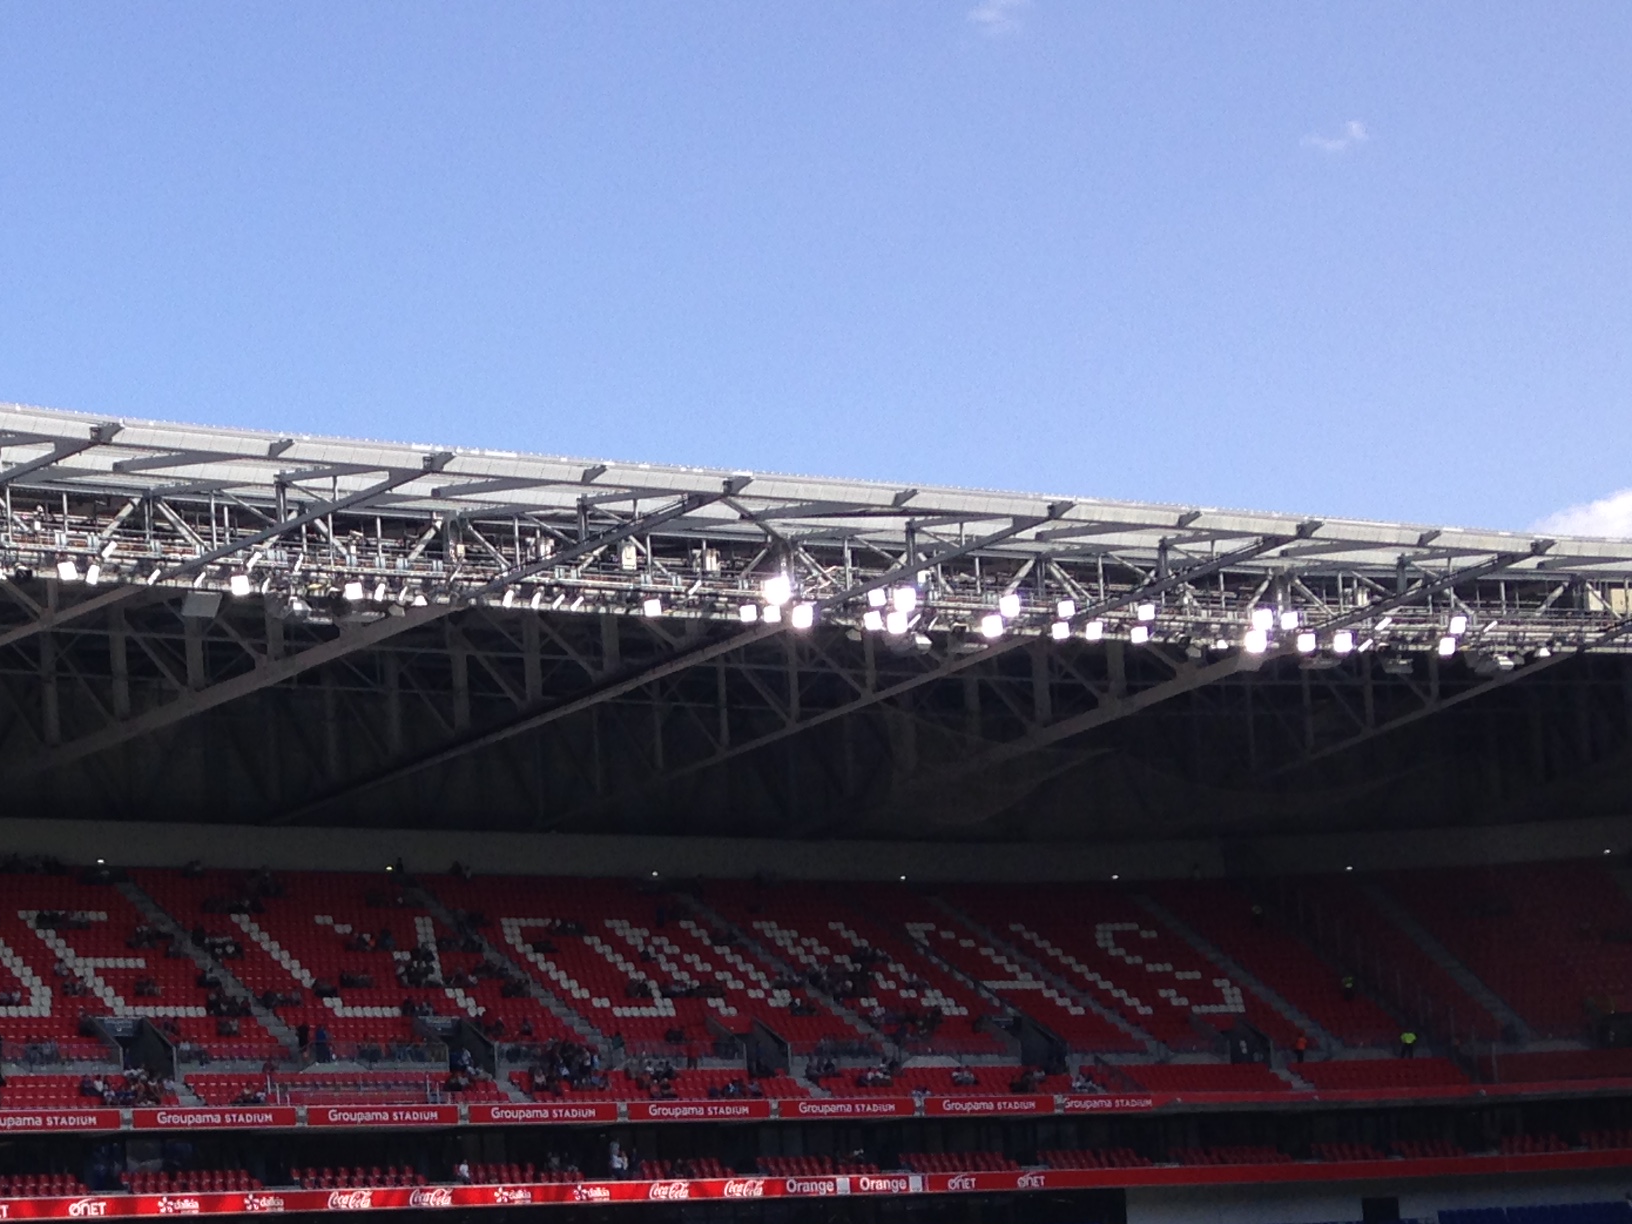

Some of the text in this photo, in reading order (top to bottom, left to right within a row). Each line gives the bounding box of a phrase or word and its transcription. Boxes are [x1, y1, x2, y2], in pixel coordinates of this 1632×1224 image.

[46, 1115, 97, 1126] STADIUM
[157, 1111, 273, 1126] Groupama STADIUM
[328, 1109, 438, 1124] Groupama STADIUM
[491, 1106, 596, 1120] Groupama STADIUM
[859, 1176, 907, 1192] Orange
